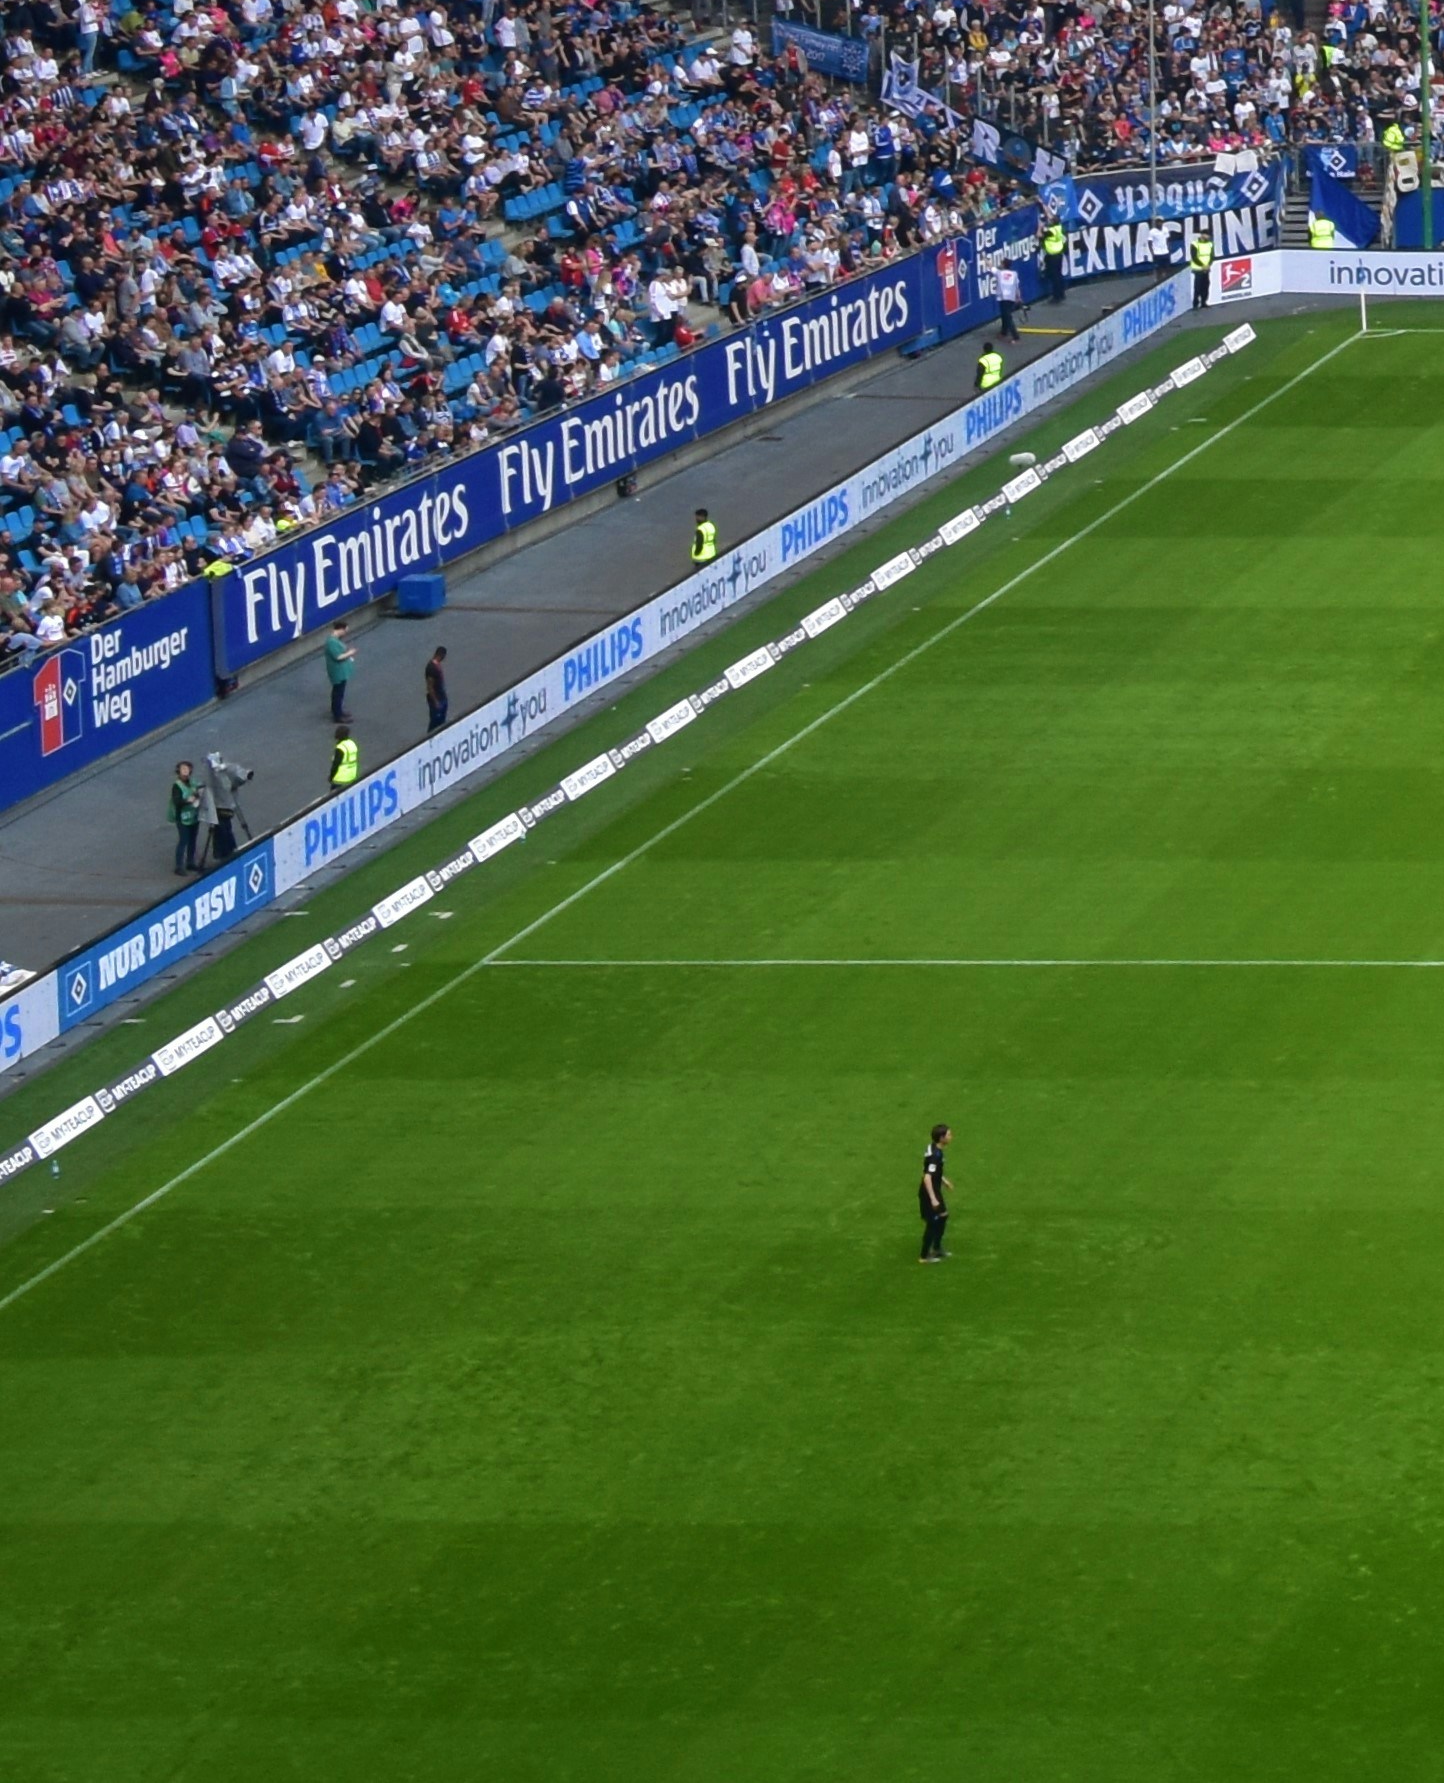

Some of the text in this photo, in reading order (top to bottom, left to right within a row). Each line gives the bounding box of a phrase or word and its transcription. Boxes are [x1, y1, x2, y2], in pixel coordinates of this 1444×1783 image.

[976, 228, 997, 253] Der
[976, 238, 1038, 275] Hamburge
[726, 278, 911, 406] Fly Emirates
[1122, 282, 1177, 345] PHILIPS
[498, 374, 701, 514] Fly Emirates
[965, 380, 1024, 445] PHILIPS
[780, 488, 850, 564] PHILIPS
[242, 483, 470, 645] Fly Emirates
[90, 627, 123, 665] Der
[90, 626, 190, 698] Hamburger
[562, 616, 645, 701] PHILIPS
[92, 688, 133, 729] Weg
[417, 719, 500, 793] innovation
[303, 768, 399, 868] PHILIPS
[99, 877, 238, 992] NUR DER HSV
